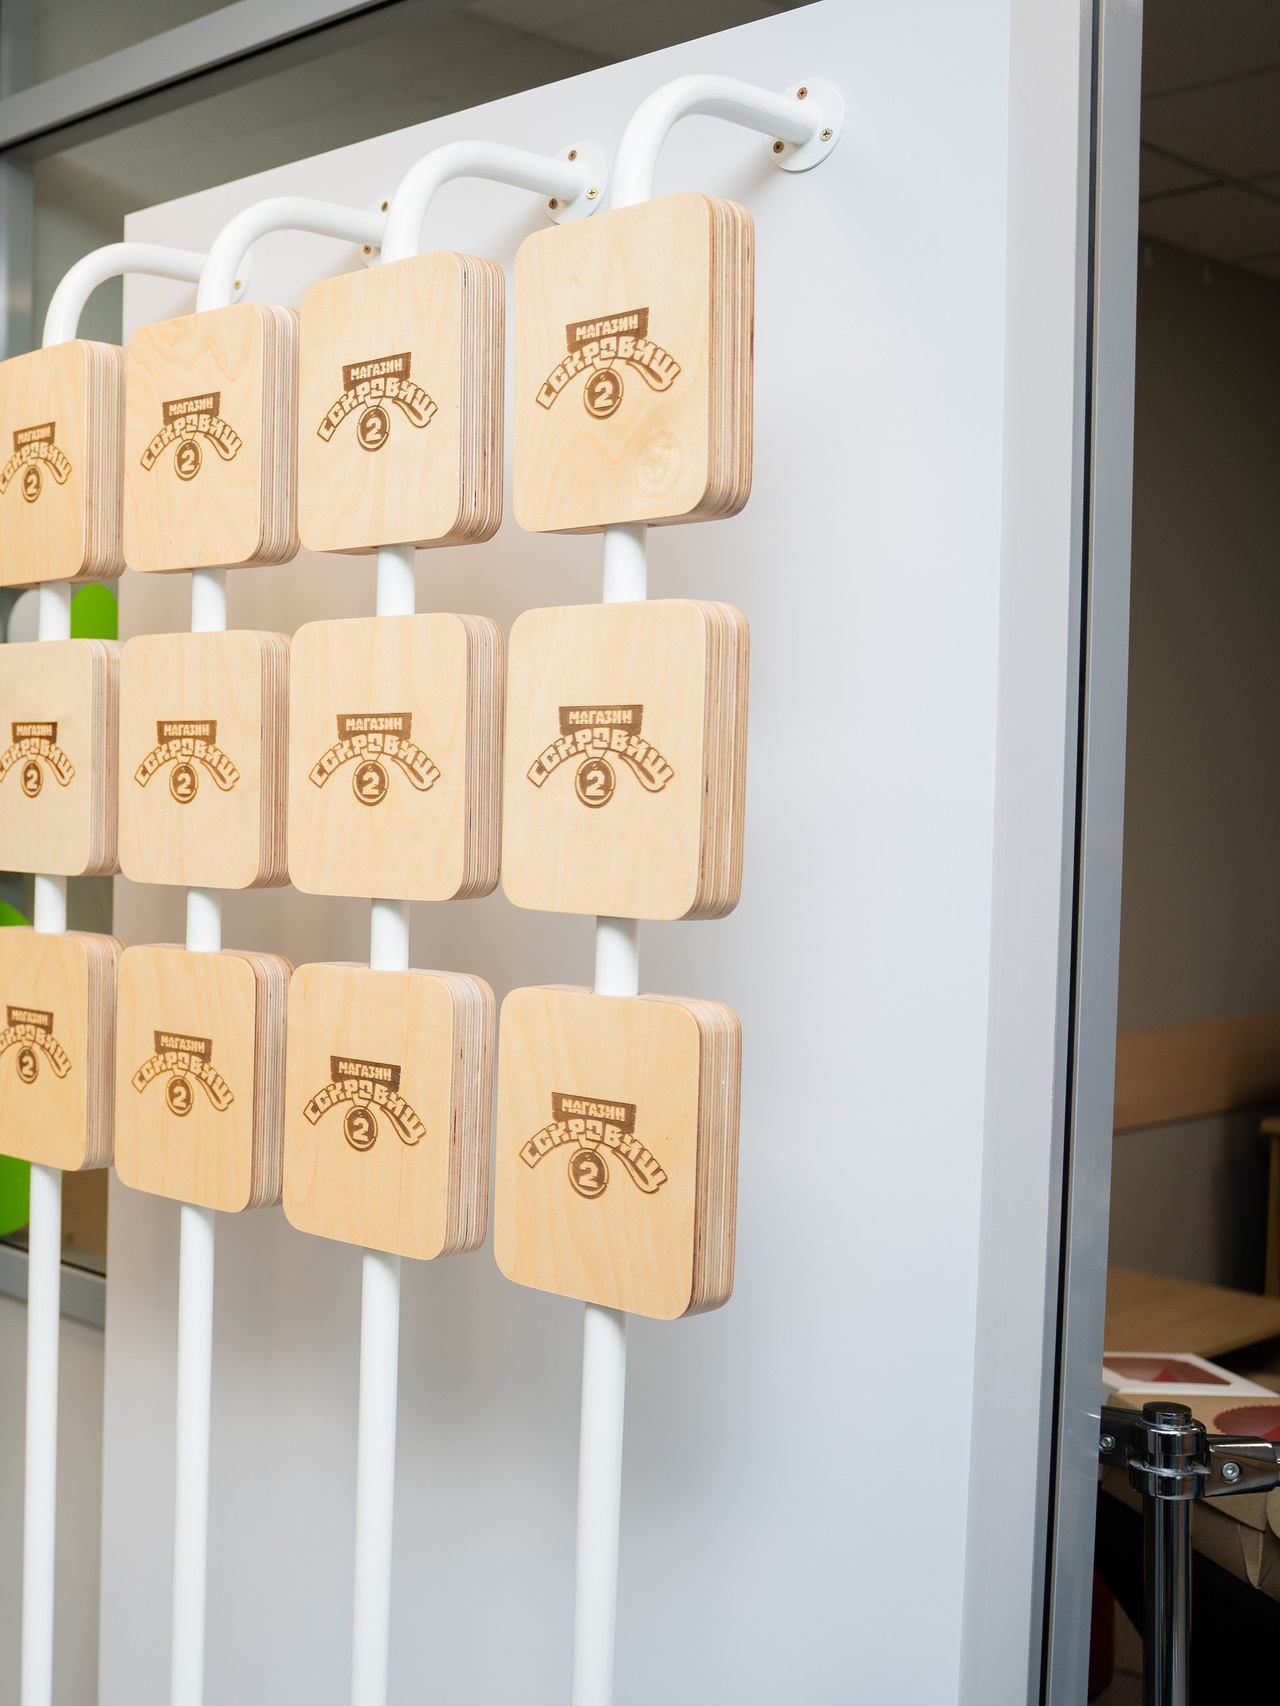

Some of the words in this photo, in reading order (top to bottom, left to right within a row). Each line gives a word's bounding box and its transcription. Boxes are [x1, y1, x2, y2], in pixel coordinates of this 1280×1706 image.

[575, 314, 638, 341] МАГАЗИН
[350, 358, 403, 381] МАГАЗИН
[169, 397, 213, 416] МАГАЗИН
[17, 426, 51, 444] МАГАЗИН
[345, 717, 403, 731] МАГАЗИН
[569, 709, 632, 725] МАГАЗИН
[16, 724, 53, 737] МАГАЗИН
[163, 724, 210, 737] МАГАЗИН
[11, 1009, 49, 1026] МАГАЗИН
[160, 1035, 206, 1054] МАГАЗИН
[338, 1061, 392, 1082] МАГАЗИН
[561, 1098, 625, 1122] МАГАЗИН
